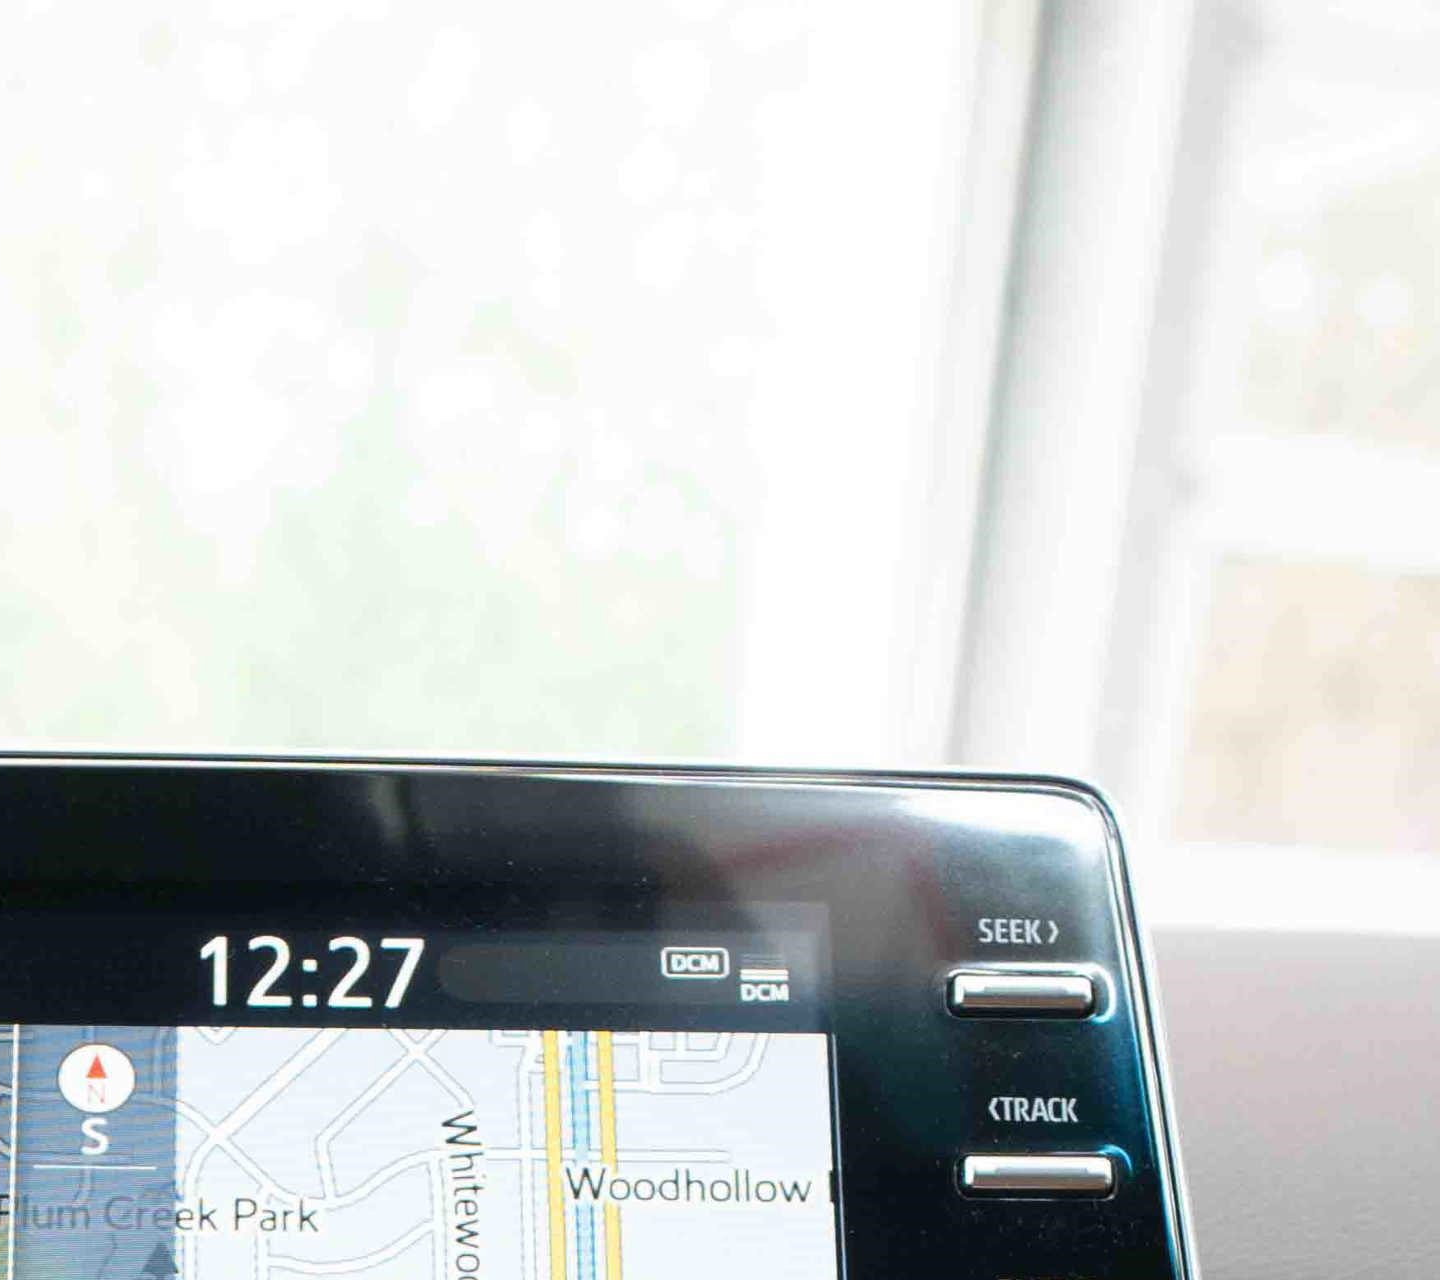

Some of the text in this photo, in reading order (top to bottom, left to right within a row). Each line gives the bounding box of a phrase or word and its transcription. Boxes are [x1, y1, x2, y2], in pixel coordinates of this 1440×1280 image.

[199, 935, 426, 1008] 12:27
[671, 954, 719, 972] DCM
[740, 984, 789, 1001] DCM
[81, 1117, 110, 1155] S
[566, 1167, 812, 1202] Woodhollow
[105, 1196, 218, 1232] Creek
[234, 1199, 319, 1235] Park
